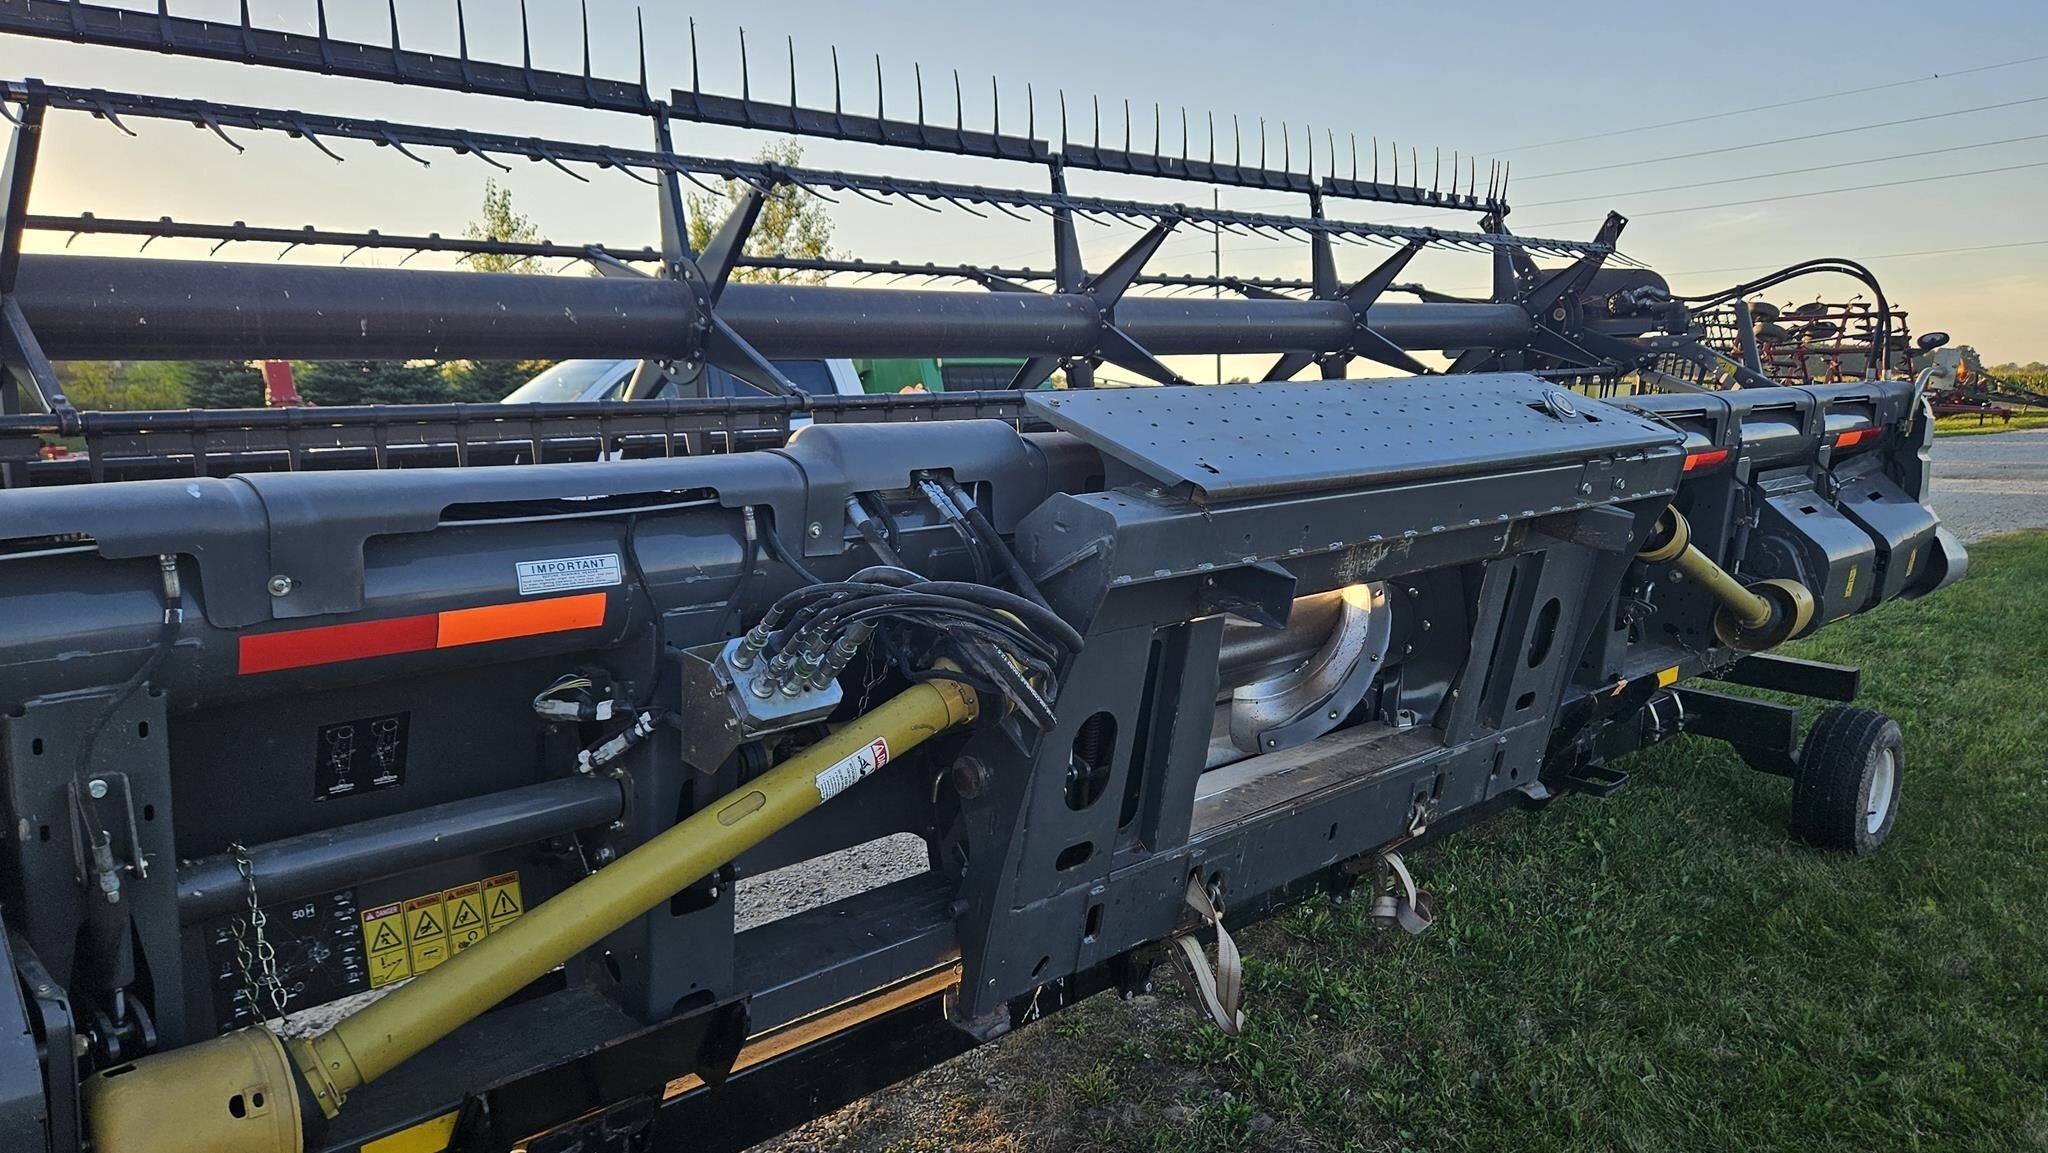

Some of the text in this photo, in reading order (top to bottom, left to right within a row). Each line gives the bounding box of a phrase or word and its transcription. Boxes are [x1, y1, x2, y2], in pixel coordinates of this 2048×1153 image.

[531, 559, 606, 574] IMPORTANT
[292, 910, 305, 919] 50
[375, 906, 399, 918] DANGER
